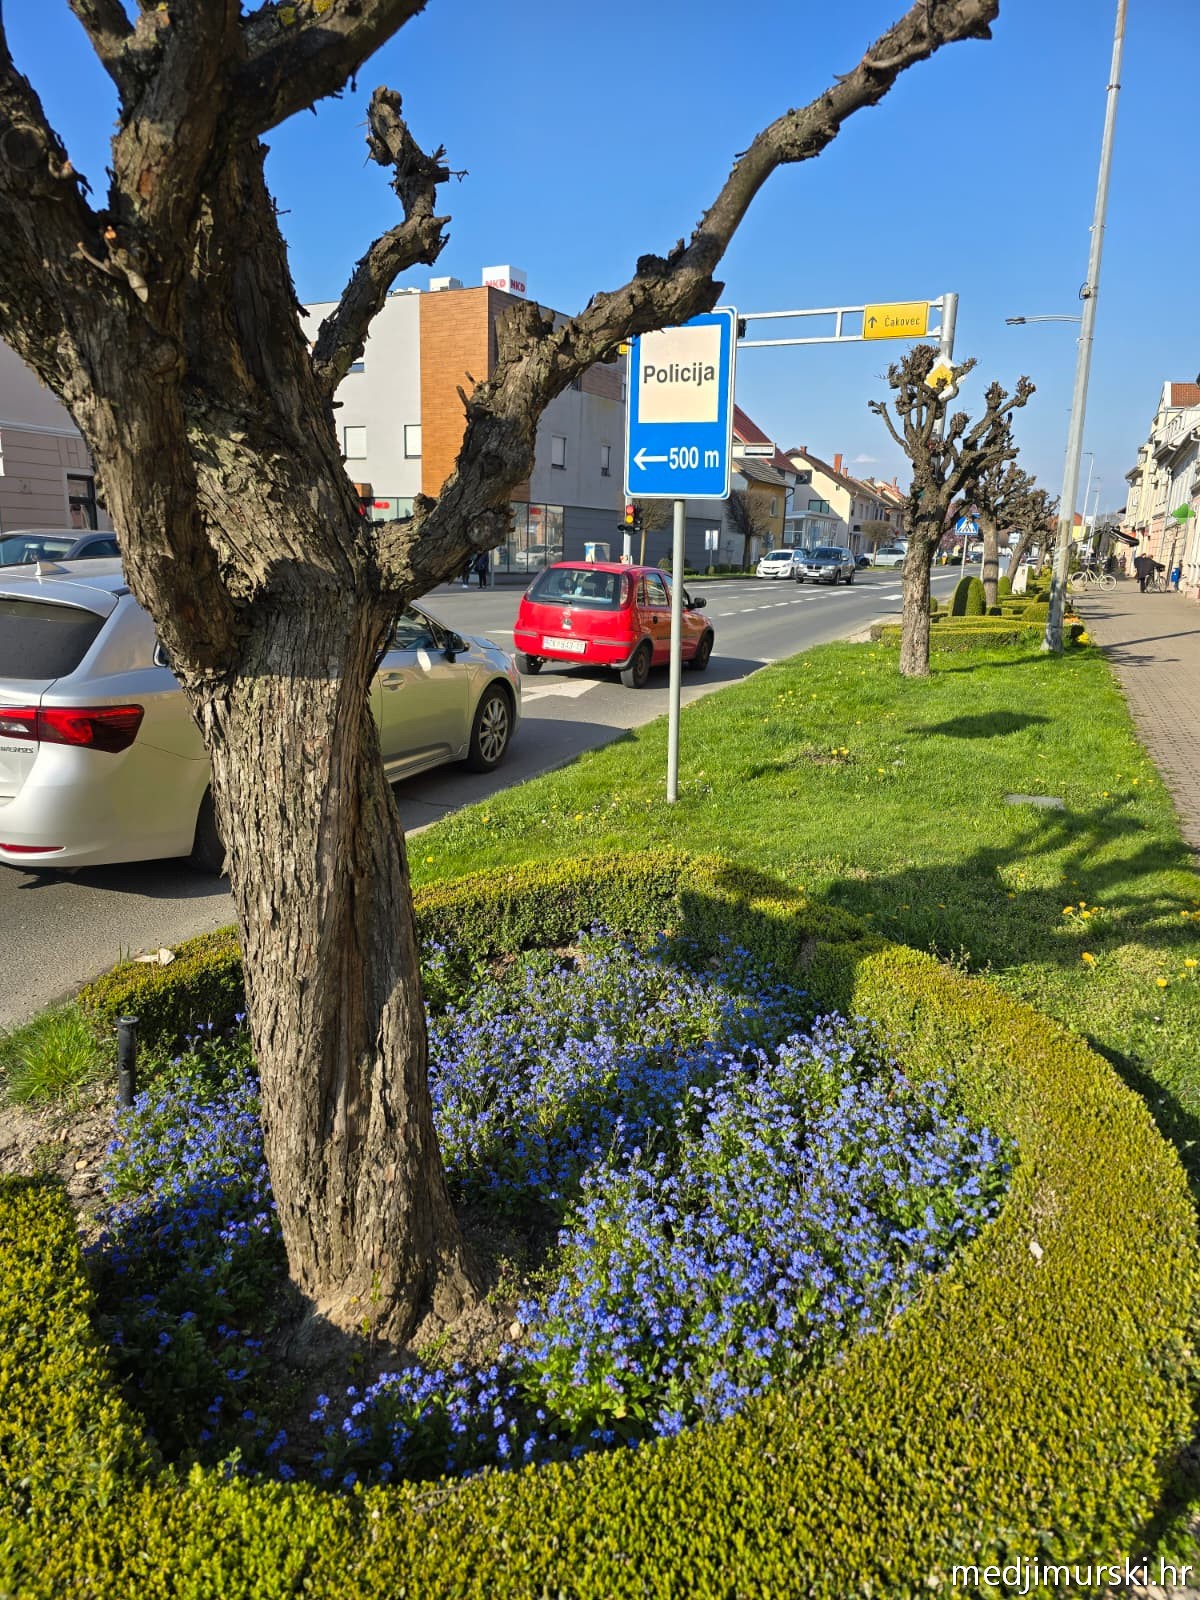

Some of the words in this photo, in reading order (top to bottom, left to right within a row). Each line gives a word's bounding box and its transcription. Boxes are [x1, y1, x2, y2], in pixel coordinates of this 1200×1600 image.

[510, 279, 526, 293] NKD
[884, 315, 920, 327] Čakovec
[643, 362, 715, 386] Policija
[669, 446, 699, 470] 500
[704, 449, 719, 468] m
